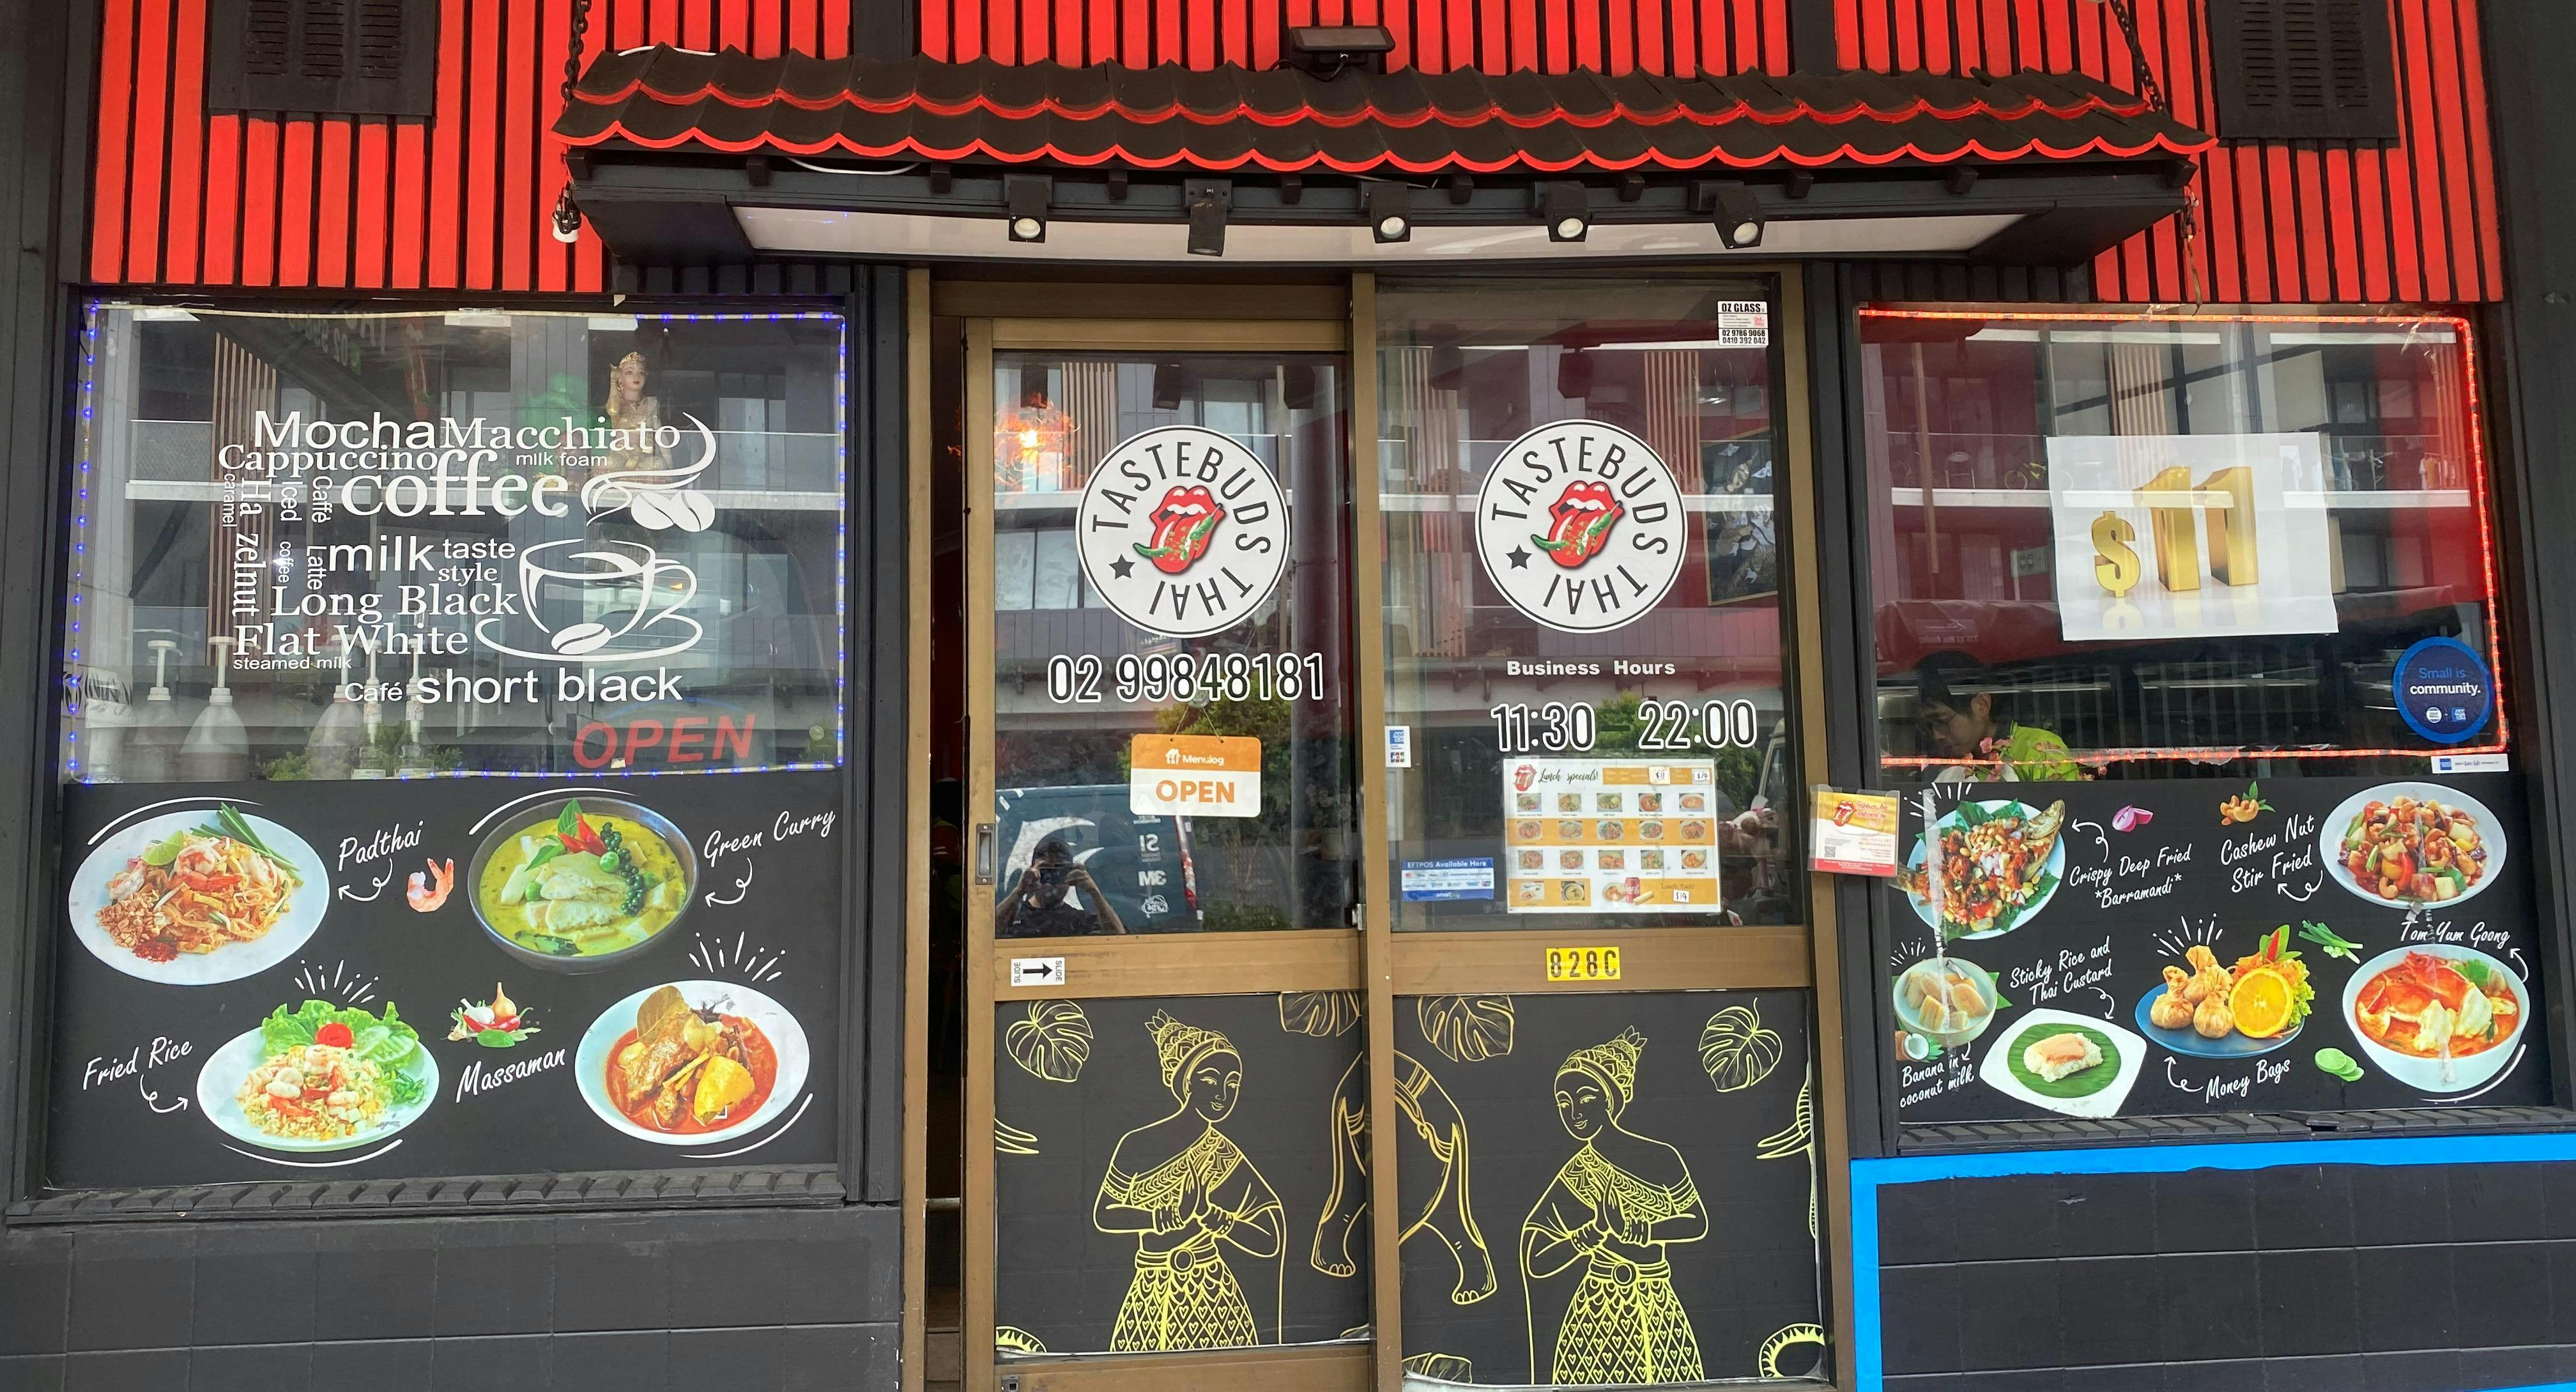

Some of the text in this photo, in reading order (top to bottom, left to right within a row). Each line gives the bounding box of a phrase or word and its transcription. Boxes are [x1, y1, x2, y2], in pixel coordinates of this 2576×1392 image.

[1721, 303, 1761, 312] OZ GLASS
[254, 410, 437, 450] Mocha
[441, 416, 681, 451] Macchiato
[218, 444, 439, 478] Cappuccino
[516, 452, 608, 468] milk foam
[222, 473, 238, 527] caramel
[280, 480, 304, 521] Iced
[341, 448, 569, 518] coffee
[1092, 441, 1271, 555] TASTEBUDS
[1491, 436, 1669, 555] TASTEBUDS
[278, 540, 295, 583] coffee
[306, 546, 327, 590] Latte
[329, 534, 435, 572] milk
[443, 538, 516, 560] taste
[438, 562, 498, 586] style
[1149, 566, 1254, 620] THAI
[1542, 564, 1649, 615] THAI
[270, 584, 519, 624] Long Black
[233, 622, 470, 656] Flat White
[233, 657, 352, 670] steamed milk
[1047, 652, 1324, 703] 02 99848181
[1506, 659, 1676, 676] Business Hours
[2419, 667, 2466, 679] Small is
[344, 668, 684, 705] Café short black
[2410, 682, 2481, 696] community.
[572, 713, 758, 769] OPEN
[1491, 701, 1596, 753] 11:30
[1638, 699, 1758, 749] 22:00
[1182, 754, 1225, 766] Menulog
[1538, 768, 1561, 783] Lunch
[1567, 769, 1598, 784] specials!
[1156, 779, 1235, 803] OPEN
[338, 820, 424, 871] Padthai
[703, 808, 837, 866] Green Curry
[2220, 813, 2315, 866] Cashew Nut
[2069, 843, 2192, 888] Crispy Deep Fried
[2231, 845, 2313, 893] Stir Fried
[2400, 921, 2511, 951] Tom Yum Goong
[1550, 950, 1617, 977] 828C
[2009, 935, 2111, 989] Sticky Rice and
[2029, 958, 2112, 1006] Thai Custard
[82, 1036, 194, 1090] Fried Rice
[456, 1048, 566, 1103] Massaman
[1901, 1055, 1959, 1087] Banana in
[2205, 1058, 2291, 1104] Money Bags
[1899, 1063, 1975, 1108] coconut milk
